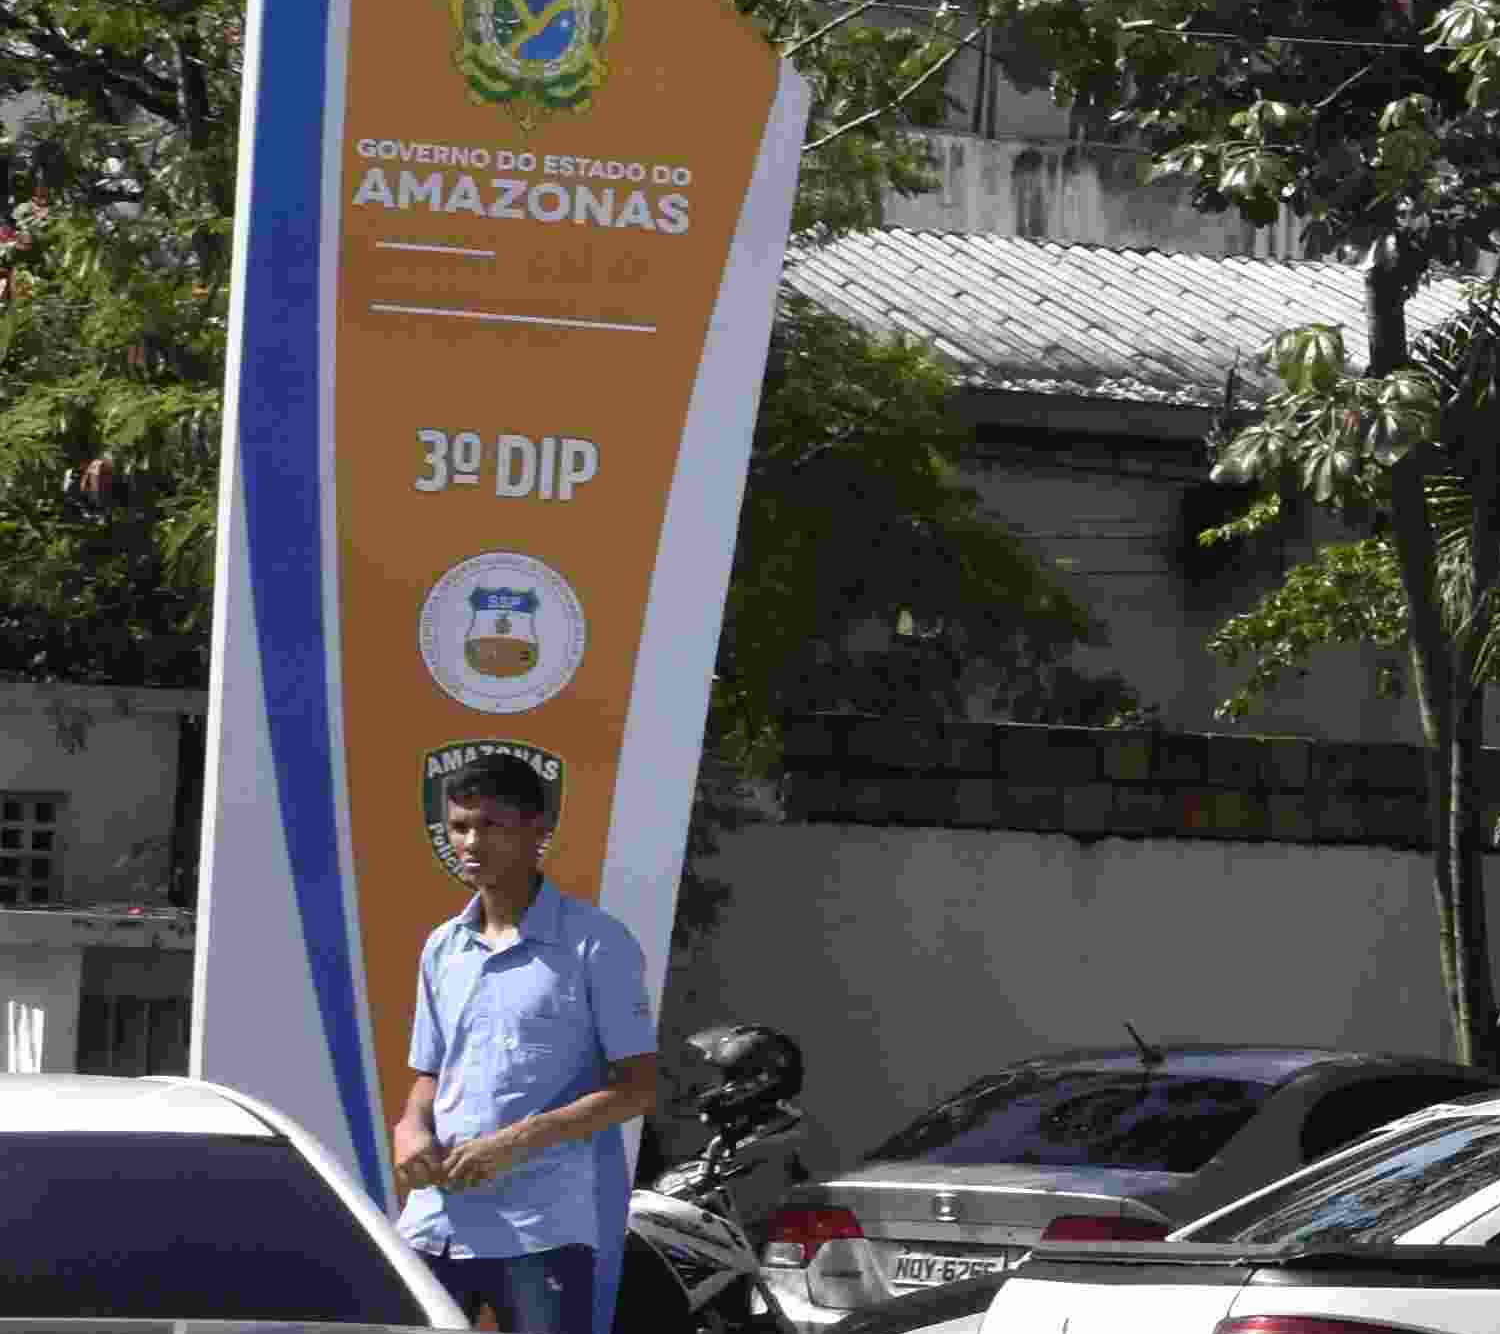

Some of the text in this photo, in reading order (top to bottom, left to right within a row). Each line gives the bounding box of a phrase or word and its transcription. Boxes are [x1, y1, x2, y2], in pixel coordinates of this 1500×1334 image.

[356, 137, 694, 187] GOVERNO DO ESTADO DO
[351, 167, 690, 236] AMAZONAS
[412, 427, 602, 501] 3º DIP
